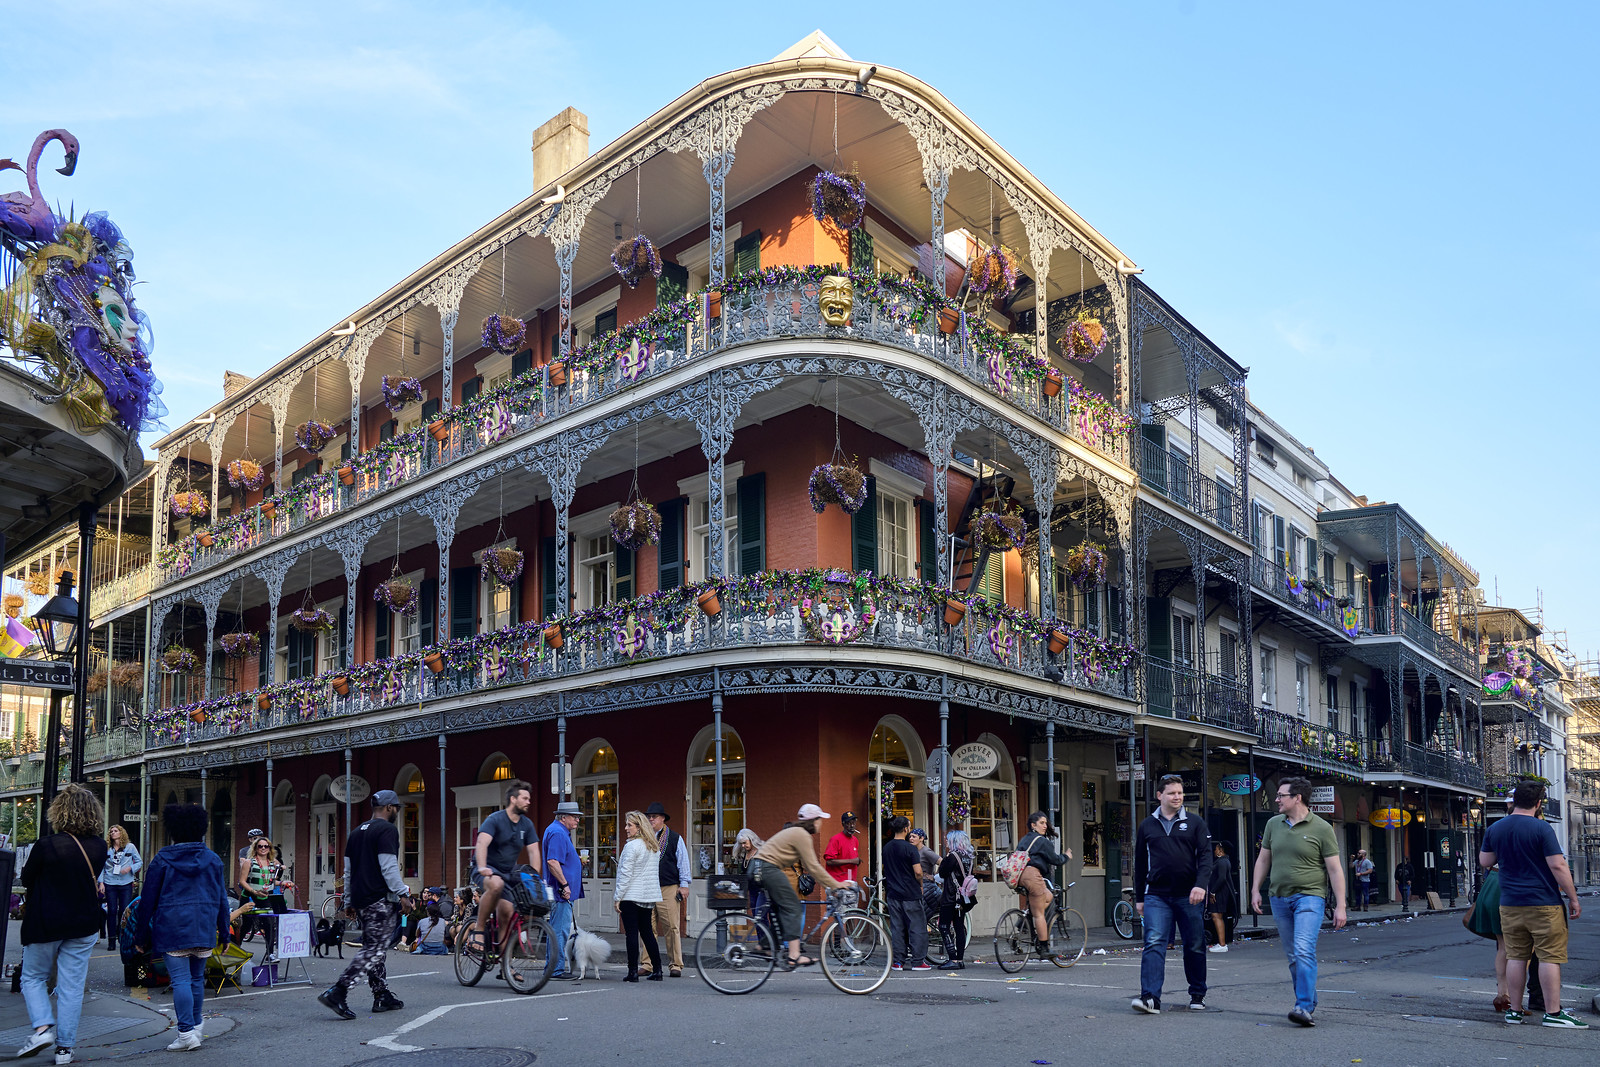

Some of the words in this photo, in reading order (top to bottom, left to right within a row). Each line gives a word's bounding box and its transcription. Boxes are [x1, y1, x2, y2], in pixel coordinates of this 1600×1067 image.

[0, 668, 14, 679] t.
[22, 667, 68, 683] Peter
[956, 745, 992, 759] FOREVER
[283, 917, 306, 934] FACE
[282, 935, 306, 954] PAINT
